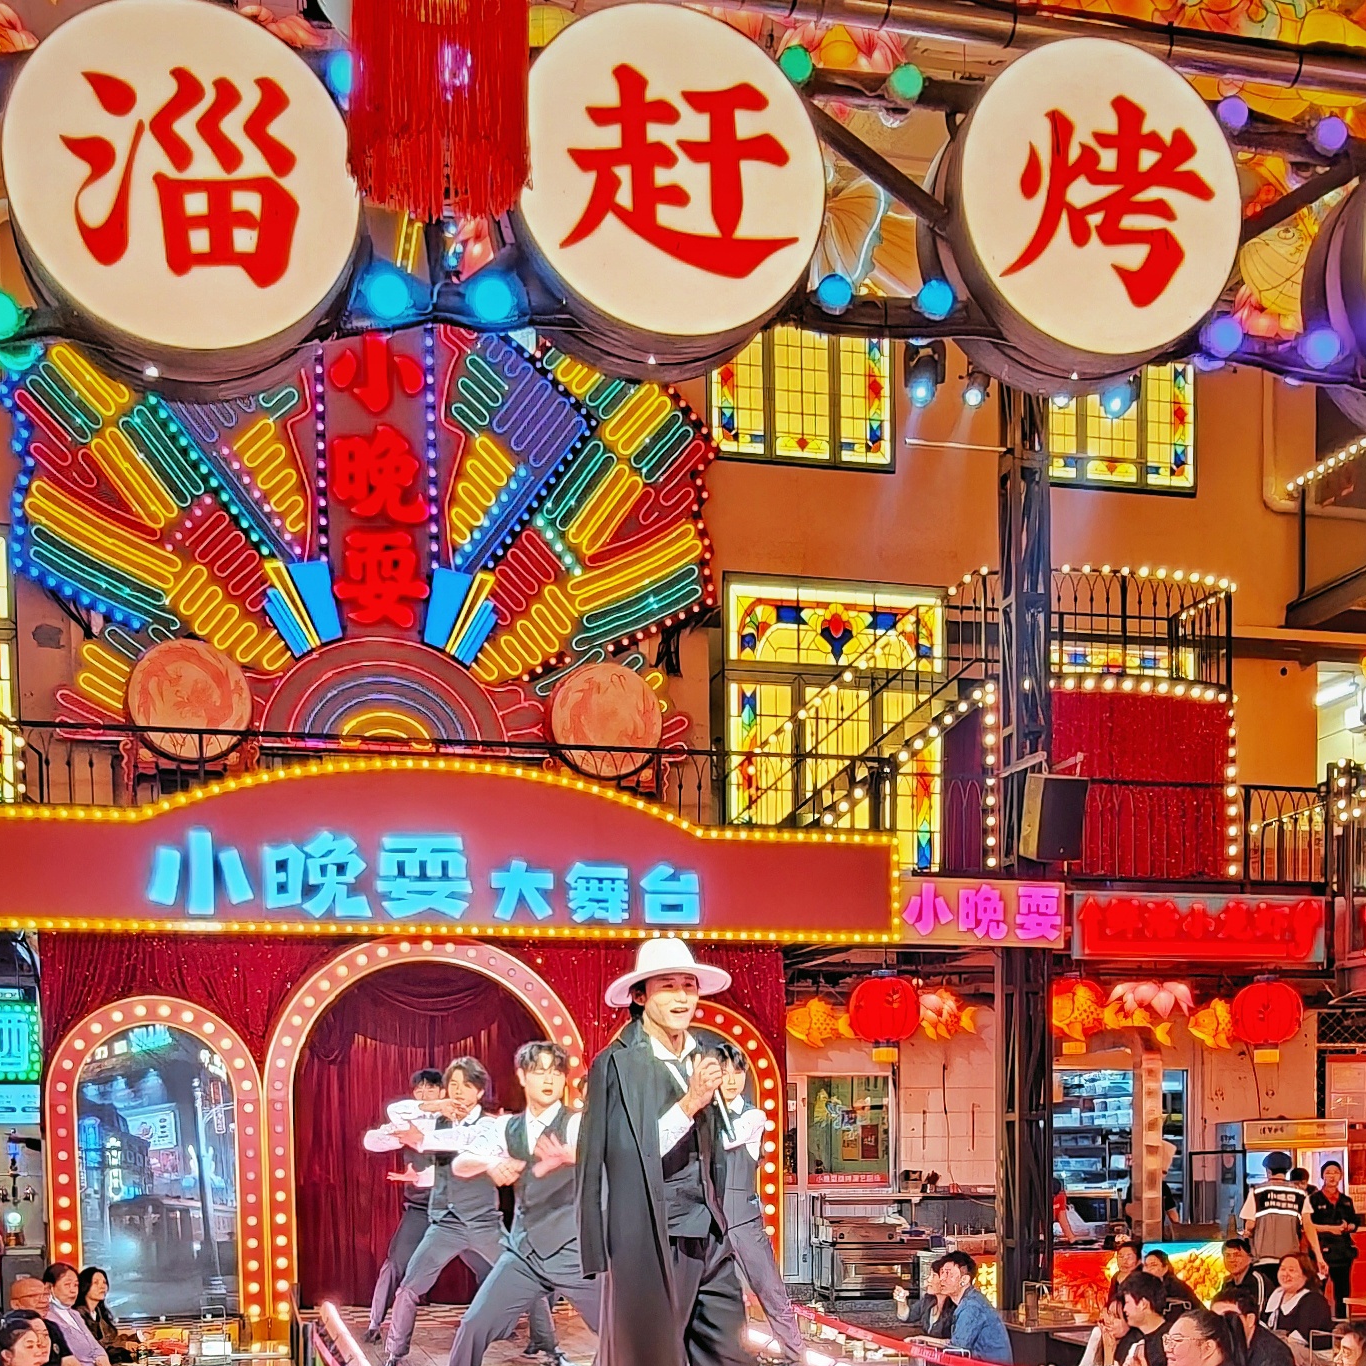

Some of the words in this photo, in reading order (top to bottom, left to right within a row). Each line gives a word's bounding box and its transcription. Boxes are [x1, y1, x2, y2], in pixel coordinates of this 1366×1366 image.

[60, 69, 299, 288] 淄
[559, 62, 799, 279] 赶
[1001, 94, 1216, 309] 烤
[330, 331, 431, 628] 小晚耍
[902, 882, 1063, 942] 小晚耍
